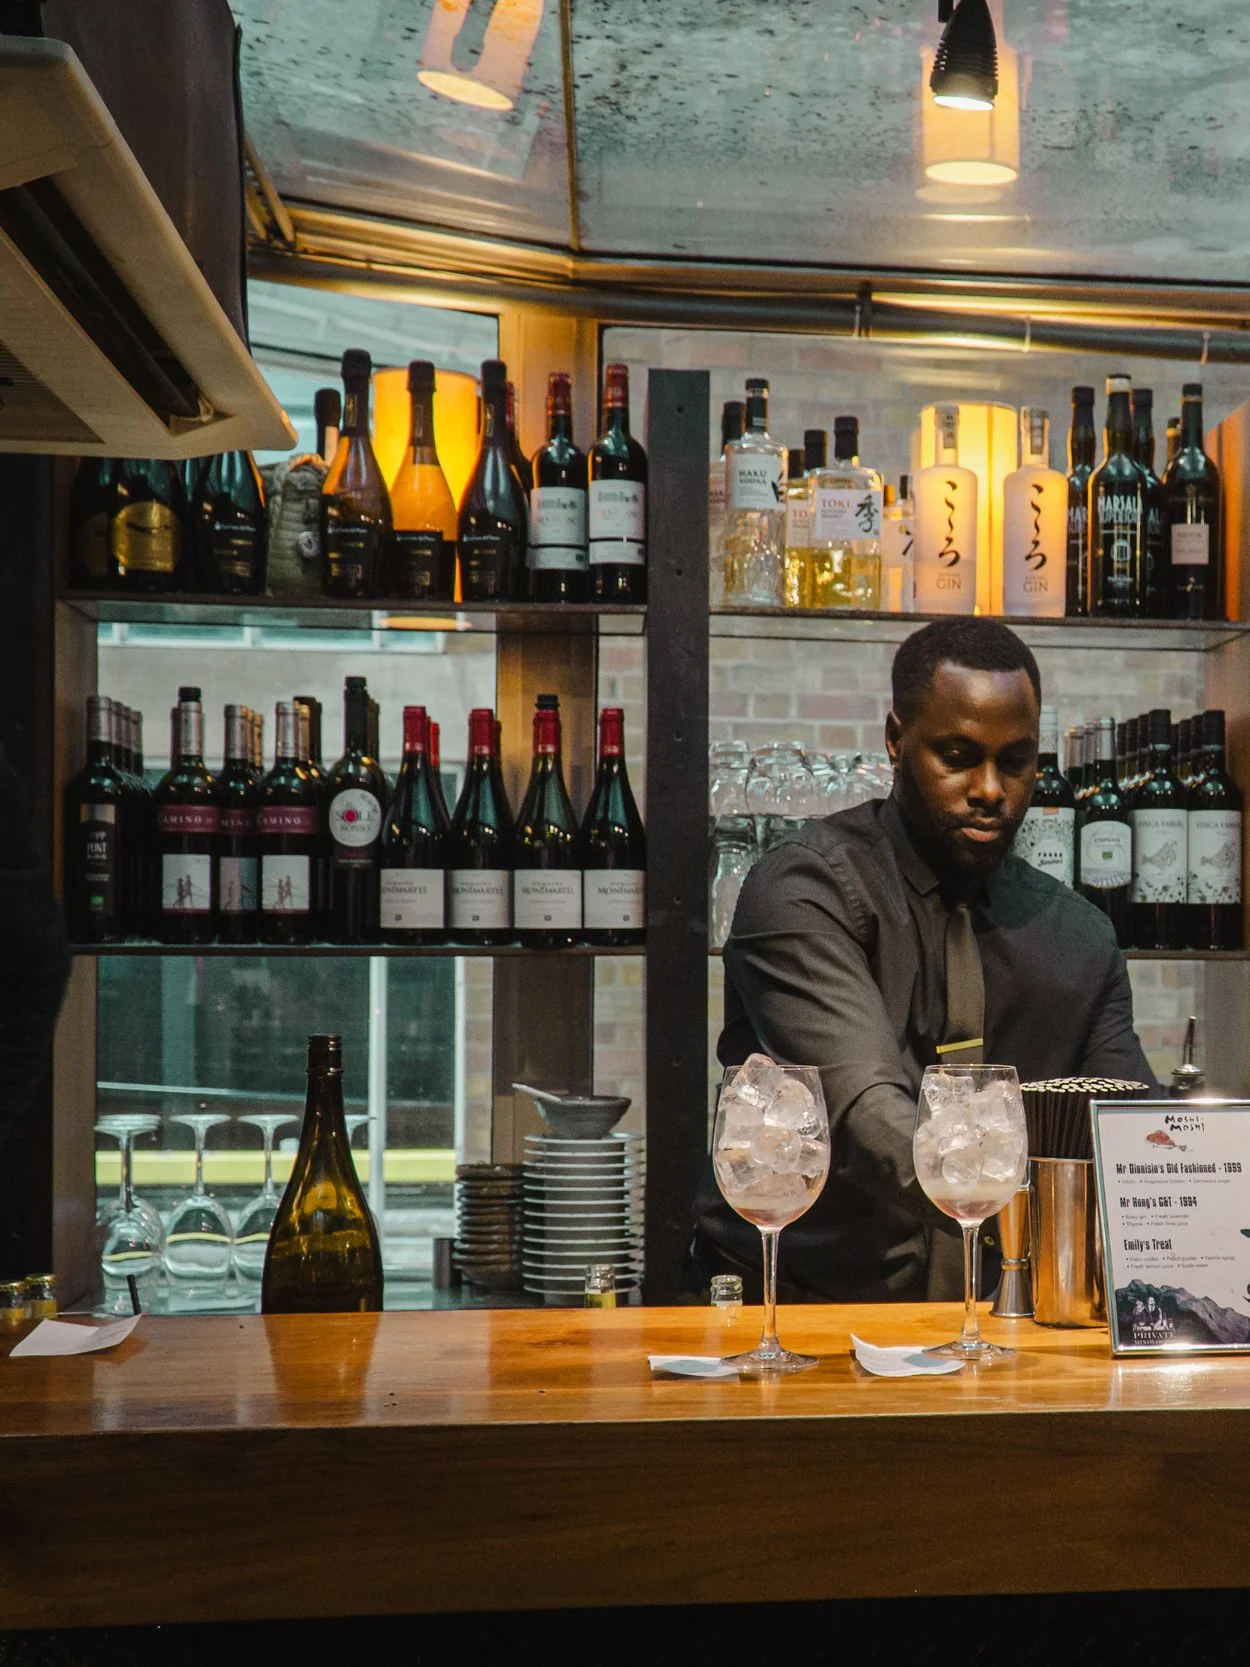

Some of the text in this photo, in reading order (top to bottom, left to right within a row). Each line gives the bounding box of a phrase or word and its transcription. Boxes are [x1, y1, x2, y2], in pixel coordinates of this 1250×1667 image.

[822, 499, 851, 508] TOKI
[936, 577, 961, 590] GIN
[1023, 580, 1048, 592] GIN
[1116, 1163, 1127, 1174] Mr
[1166, 1163, 1179, 1173] Old
[1180, 1162, 1216, 1173] Fashioned
[1119, 1197, 1131, 1208] Mr
[1132, 1196, 1157, 1209] Hong's
[1158, 1196, 1172, 1207] G&T
[1179, 1196, 1198, 1207] 1994
[1123, 1238, 1173, 1252] Emily's Treat
[1133, 1331, 1176, 1339] PRIVATE
